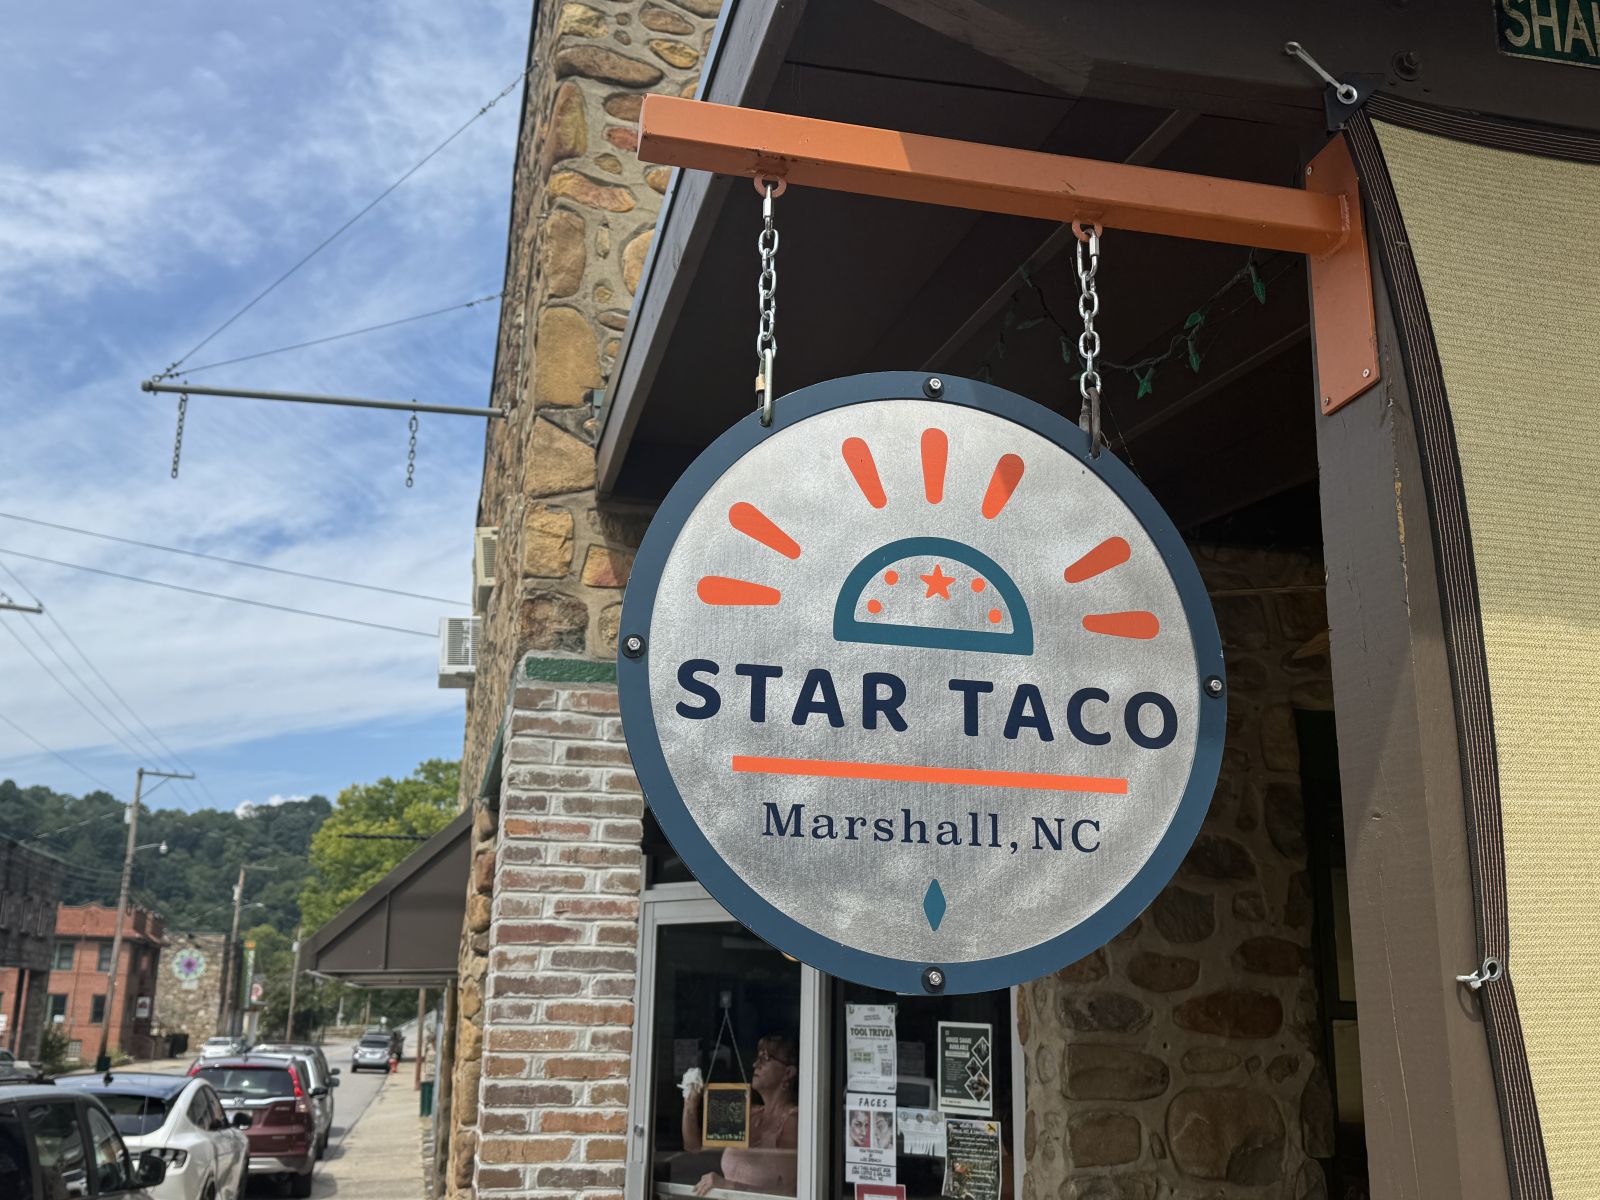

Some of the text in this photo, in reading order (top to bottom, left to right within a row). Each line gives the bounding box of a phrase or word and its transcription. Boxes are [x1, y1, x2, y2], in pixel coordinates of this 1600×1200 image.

[1502, 0, 1600, 57] SHA
[676, 658, 1179, 750] STAR TACO
[761, 802, 1101, 855] Marshall, NC
[850, 1027, 894, 1038] TOOL TRIVIA
[858, 1097, 888, 1108] FACES
